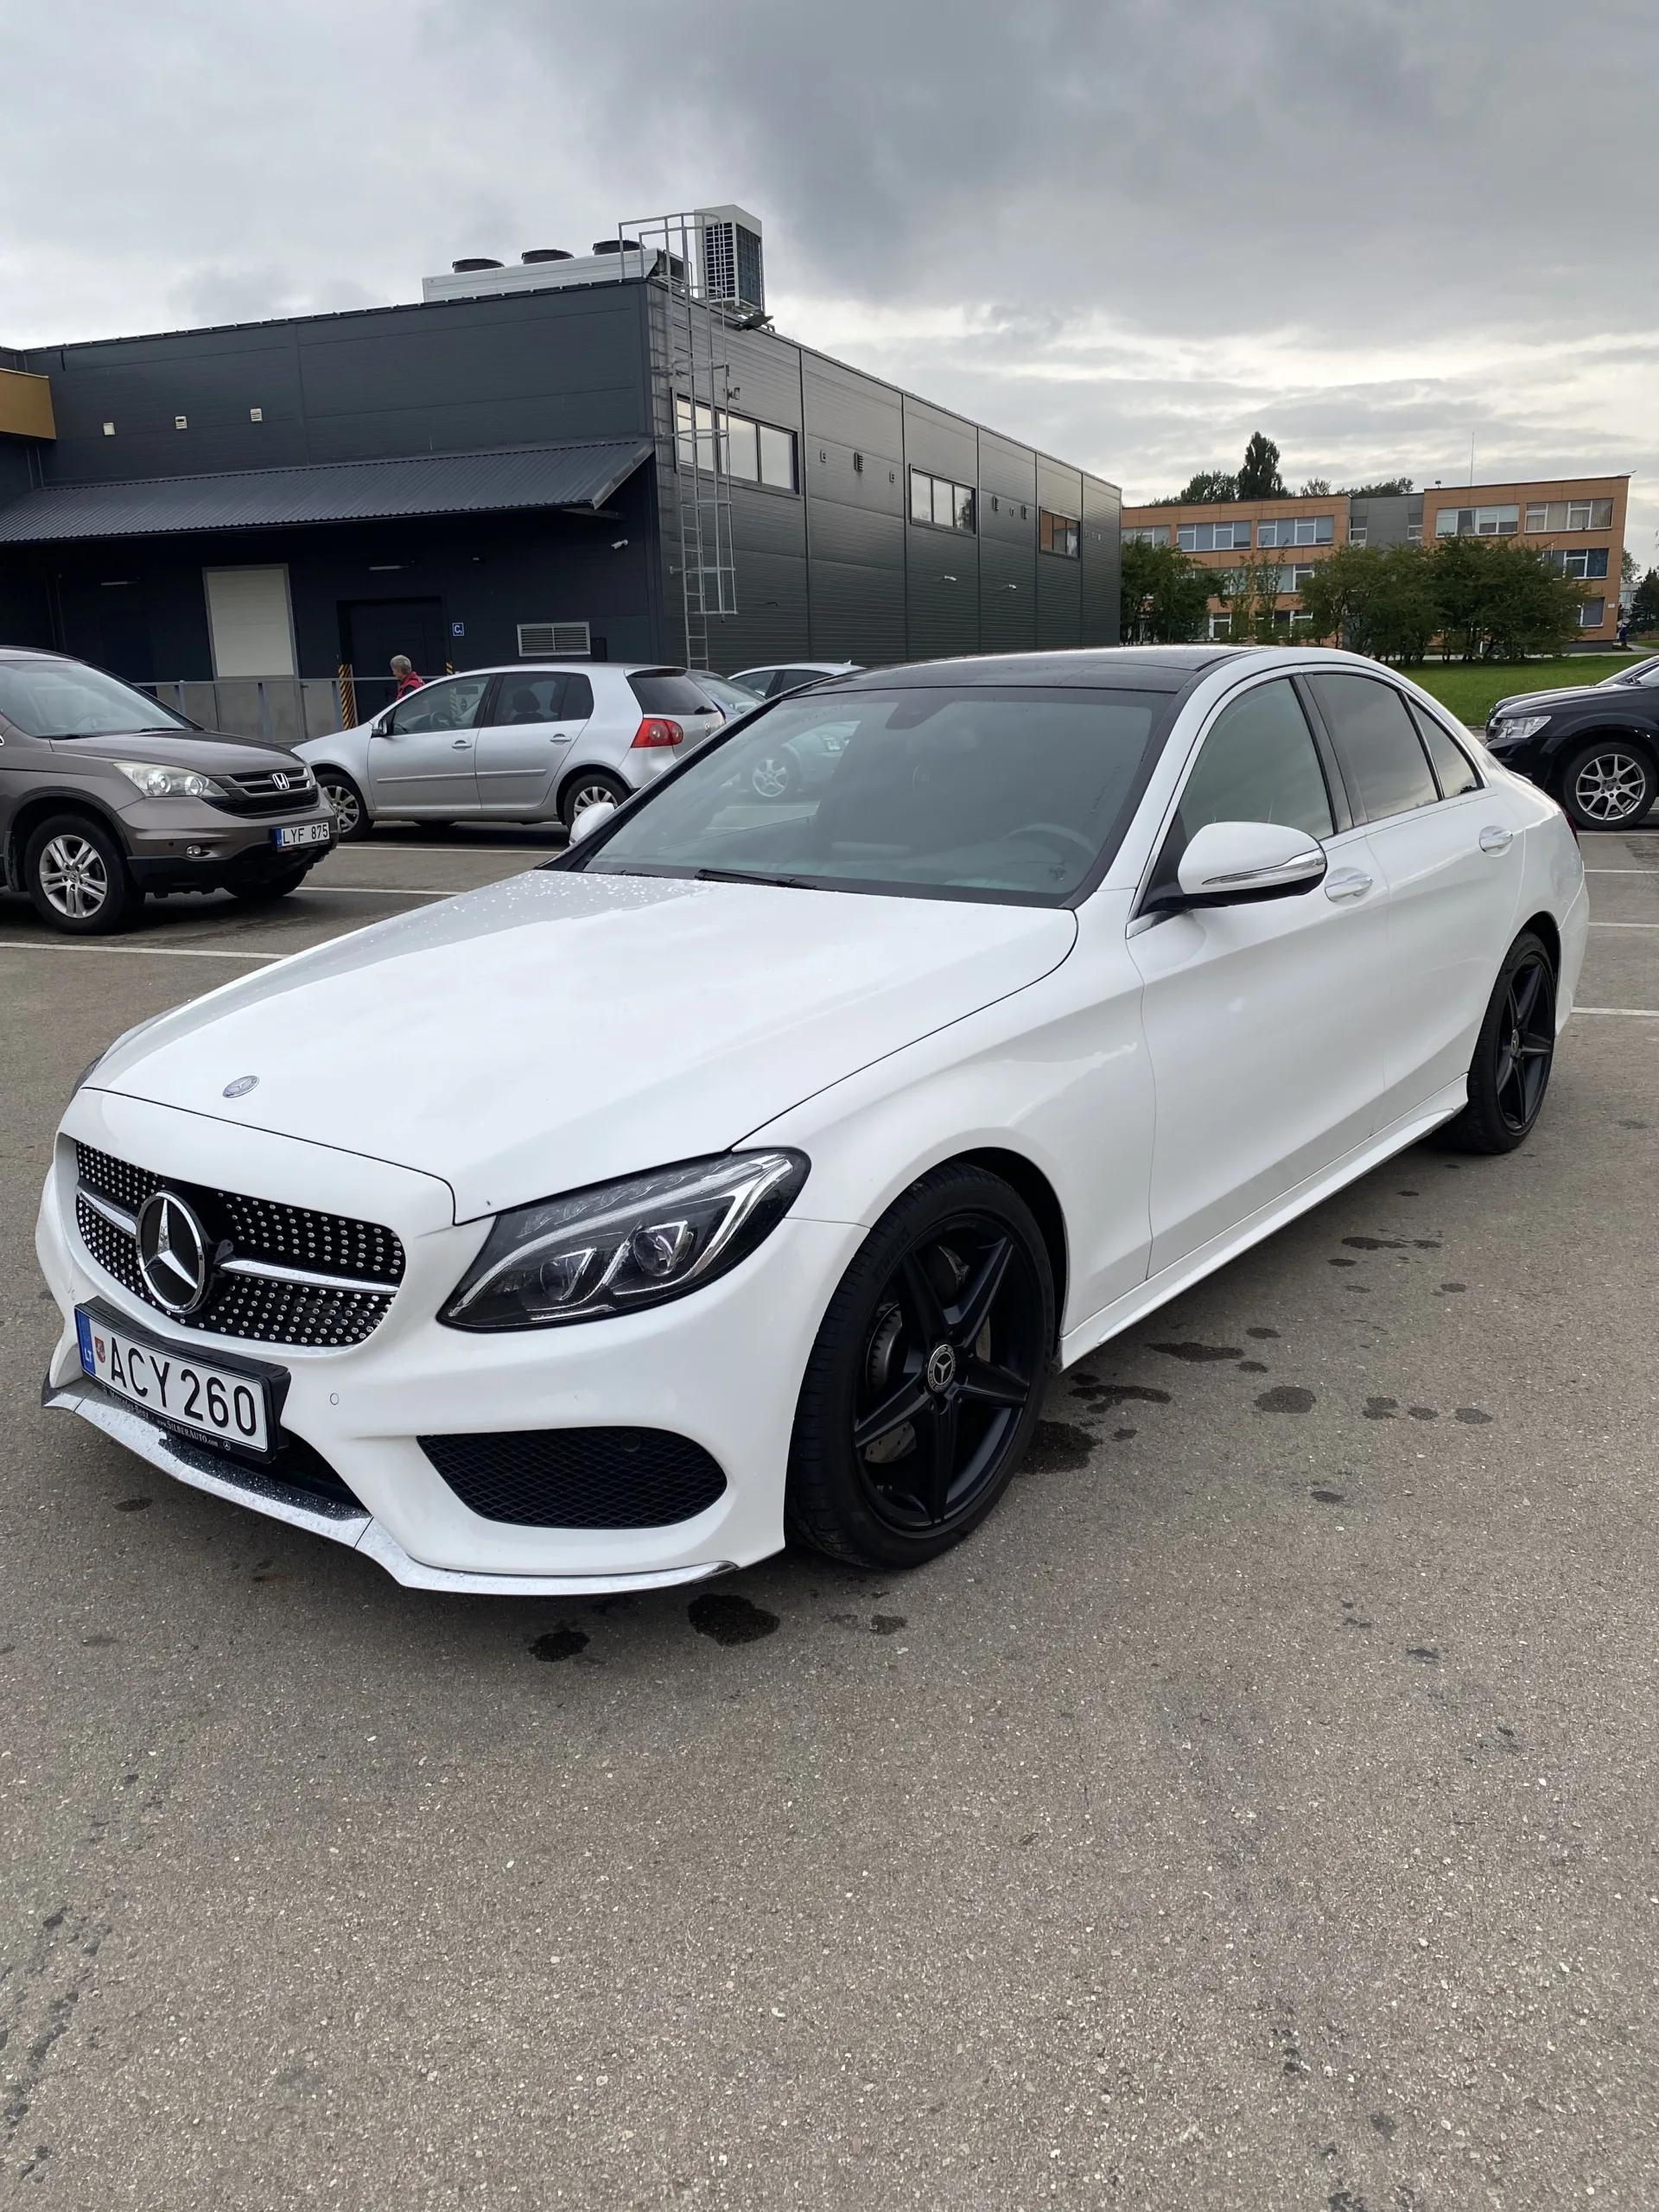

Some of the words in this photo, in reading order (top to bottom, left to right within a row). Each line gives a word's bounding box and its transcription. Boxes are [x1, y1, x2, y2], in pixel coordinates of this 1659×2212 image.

[283, 828, 305, 844] LYF
[311, 824, 328, 840] 875
[84, 1347, 92, 1363] LT
[111, 1338, 170, 1408] ACY
[181, 1369, 257, 1436] 260
